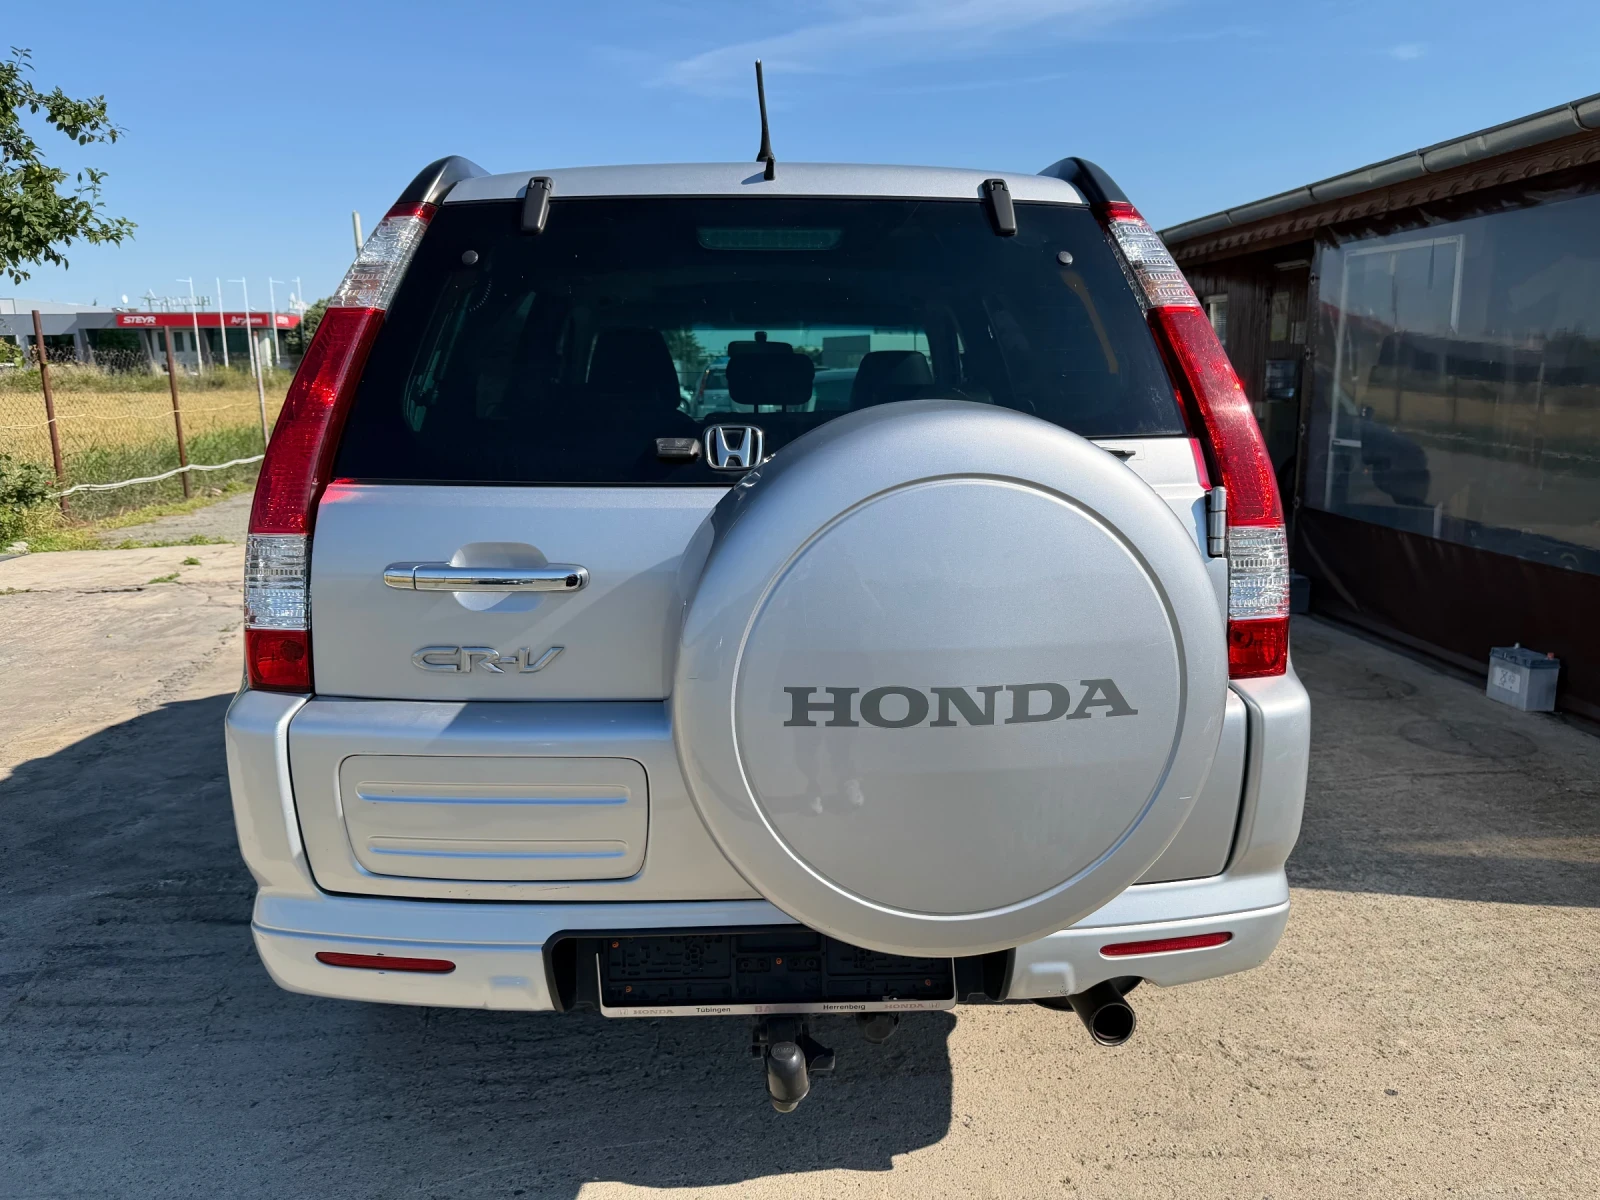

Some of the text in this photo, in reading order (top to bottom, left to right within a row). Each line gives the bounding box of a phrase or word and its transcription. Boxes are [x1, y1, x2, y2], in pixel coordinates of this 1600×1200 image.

[123, 316, 156, 324] STEYR
[412, 646, 564, 674] CR-V
[784, 679, 1138, 728] HONDA
[696, 1006, 731, 1014] Tübingen
[823, 1003, 866, 1011] Herrenberg
